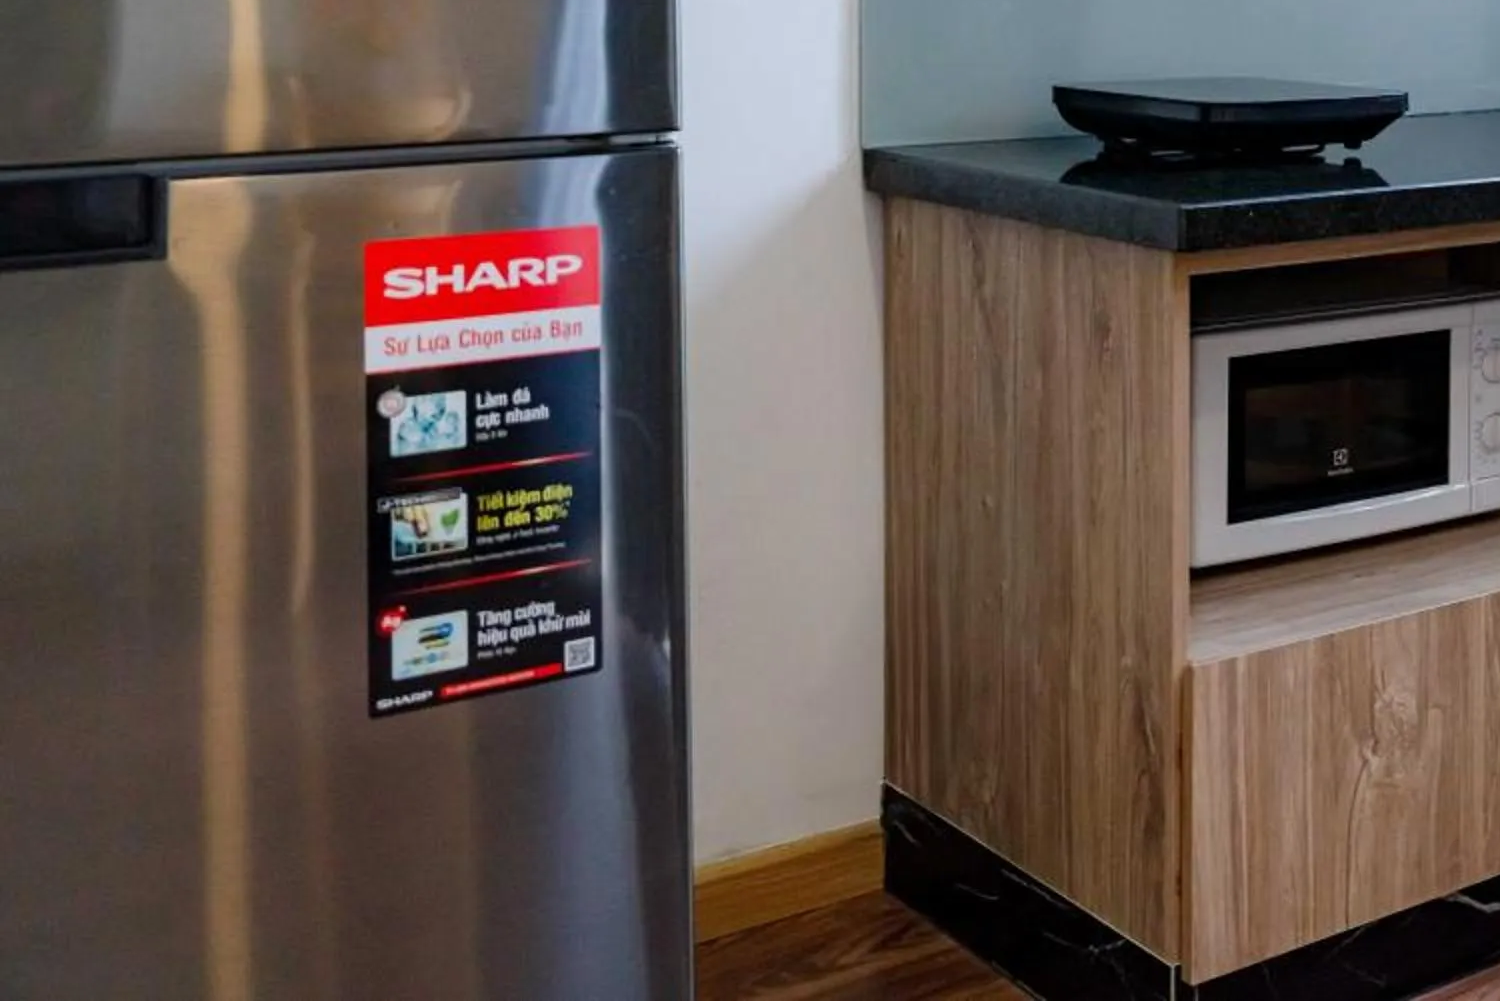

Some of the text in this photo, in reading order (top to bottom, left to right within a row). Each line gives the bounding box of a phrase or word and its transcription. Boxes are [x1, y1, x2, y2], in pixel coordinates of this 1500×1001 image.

[383, 254, 583, 299] SHARP
[459, 327, 504, 350] Chọn
[376, 690, 434, 710] SHARP
